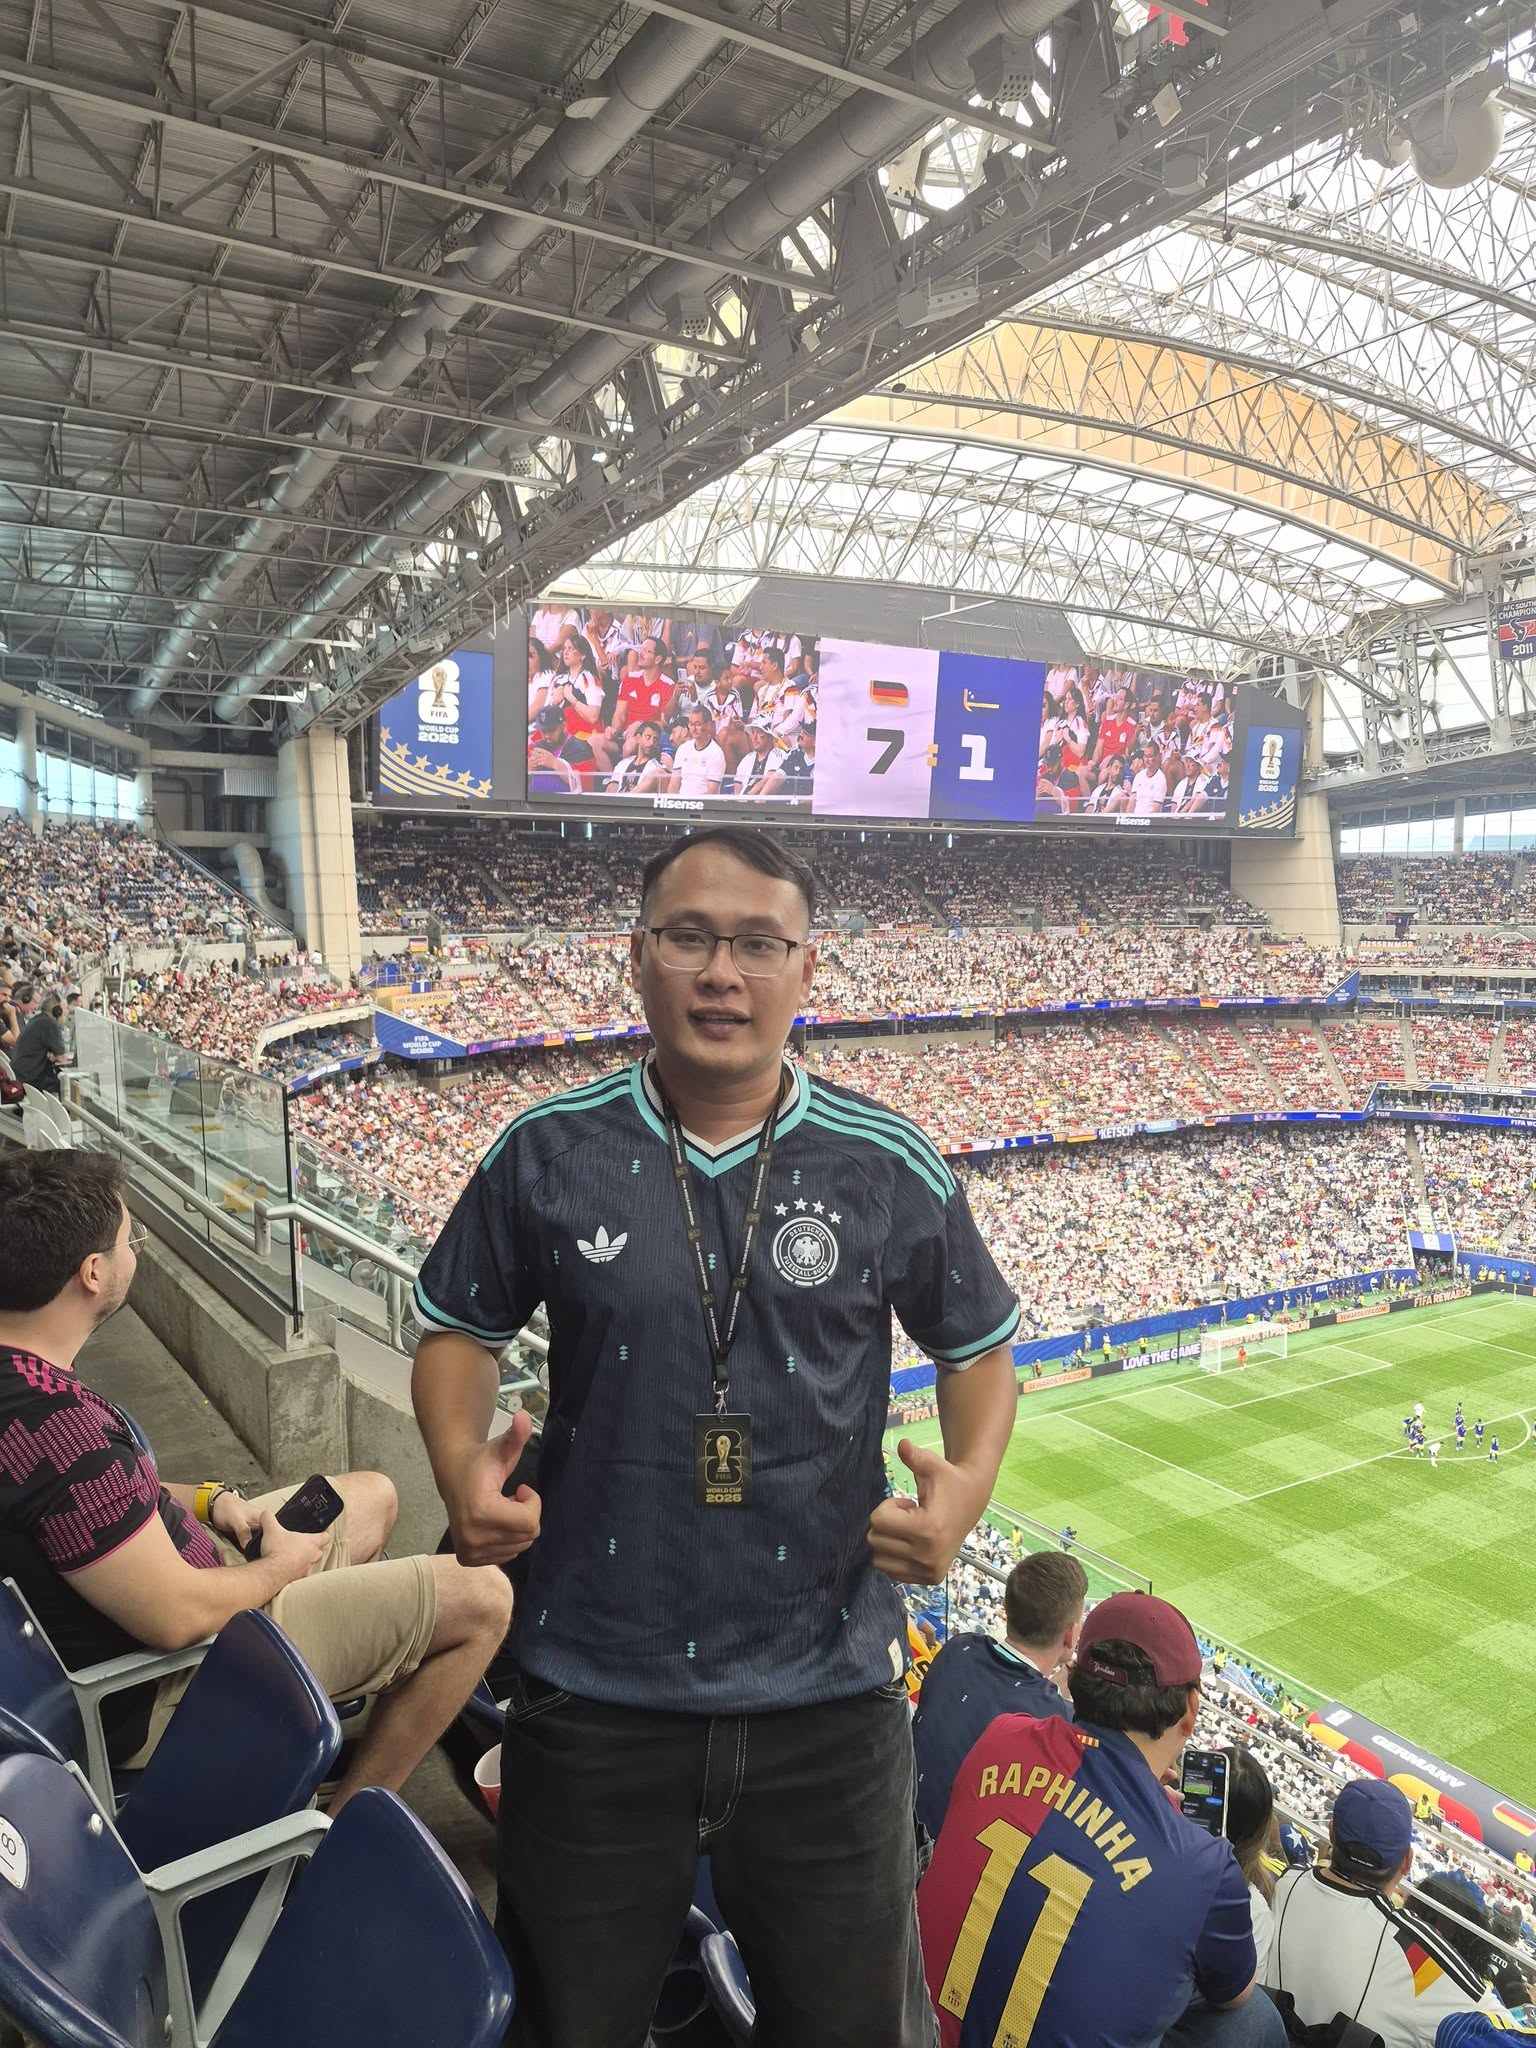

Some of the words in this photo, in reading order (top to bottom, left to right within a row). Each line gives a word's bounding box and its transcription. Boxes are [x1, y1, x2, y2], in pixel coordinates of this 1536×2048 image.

[1503, 604, 1514, 612] AFC
[1515, 600, 1536, 610] SOUTH
[1512, 642, 1533, 656] 2011
[418, 724, 444, 733] WORLD
[445, 726, 459, 734] CUP
[418, 732, 459, 744] 2026
[867, 728, 905, 774] 7
[959, 734, 994, 781] 1
[653, 797, 704, 810] Hisense
[1115, 816, 1151, 826] Hisense
[789, 1226, 826, 1242] DEUTSCHER
[1414, 1296, 1433, 1307] FIFA
[1433, 1287, 1472, 1304] REWARDS
[1123, 1353, 1150, 1370] LOVE
[1150, 1349, 1171, 1364] THE
[1171, 1343, 1201, 1360] GAME
[1028, 1372, 1087, 1390] REWARDS.FIFA.COM
[903, 1406, 931, 1424] FIFA
[705, 1493, 742, 1503] 2026
[1371, 1735, 1467, 1788] GERMANY
[979, 1762, 1153, 1892] RAPHINHA
[937, 1817, 1095, 2048] 11
